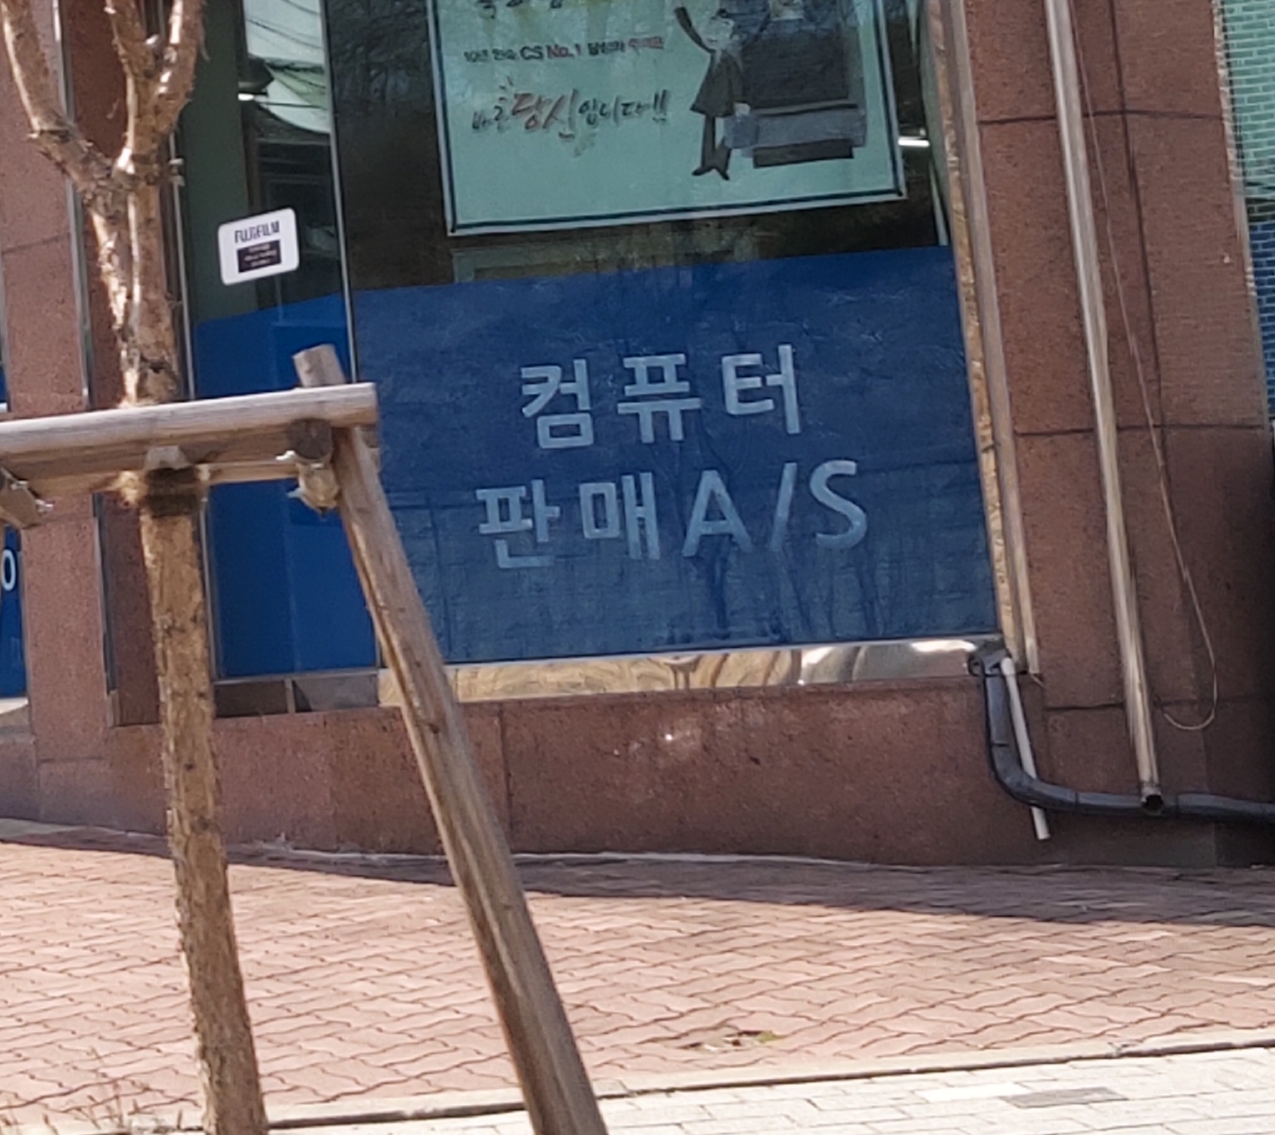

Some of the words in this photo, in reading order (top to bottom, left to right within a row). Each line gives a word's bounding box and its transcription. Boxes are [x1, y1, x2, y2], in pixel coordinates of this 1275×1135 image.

[520, 45, 544, 61] CS
[234, 219, 281, 244] FUJIFILM
[520, 343, 801, 450] 컴퓨터
